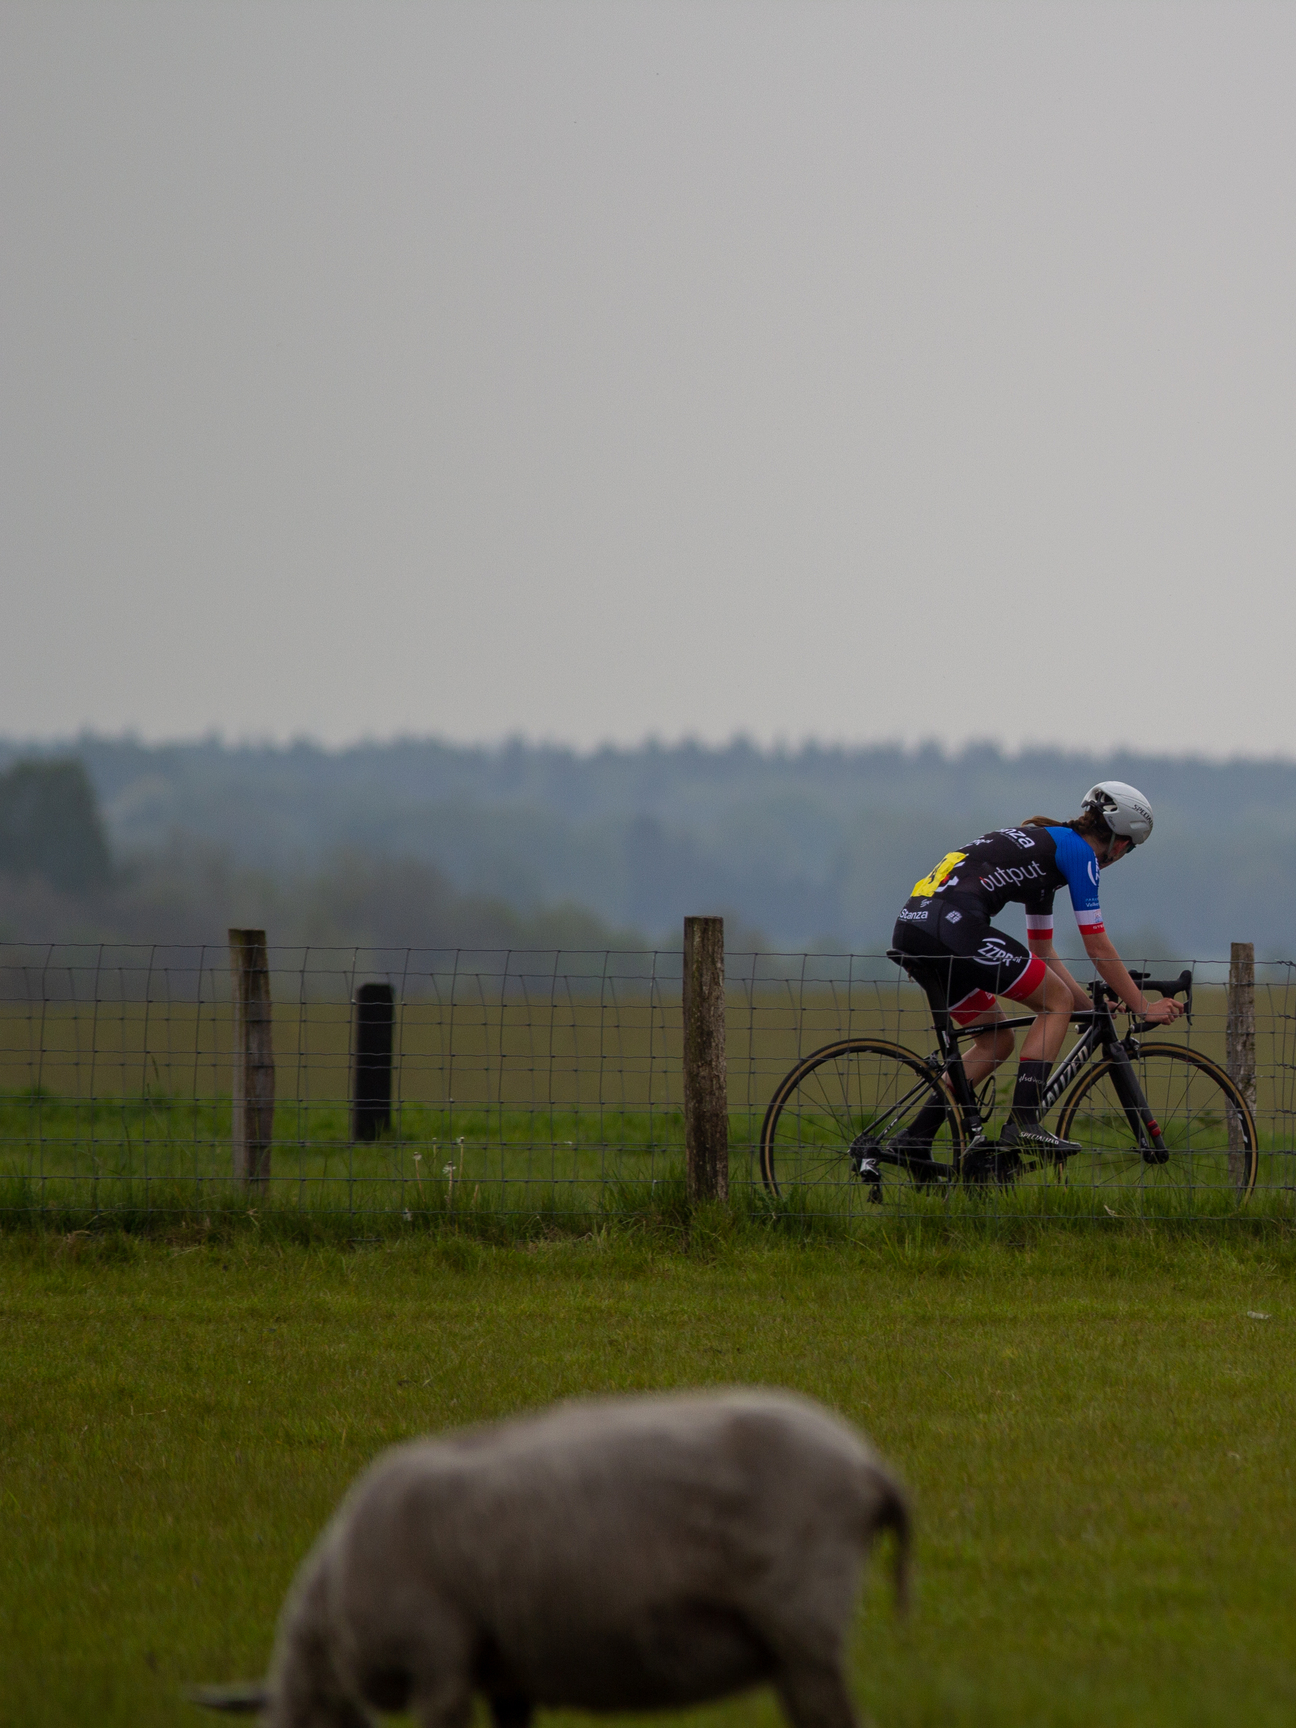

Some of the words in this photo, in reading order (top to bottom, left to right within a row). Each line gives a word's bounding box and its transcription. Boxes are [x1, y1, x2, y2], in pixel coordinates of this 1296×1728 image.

[979, 860, 1047, 892] output
[899, 908, 929, 919] Stanza
[1019, 1131, 1061, 1145] SPECIALIZED
